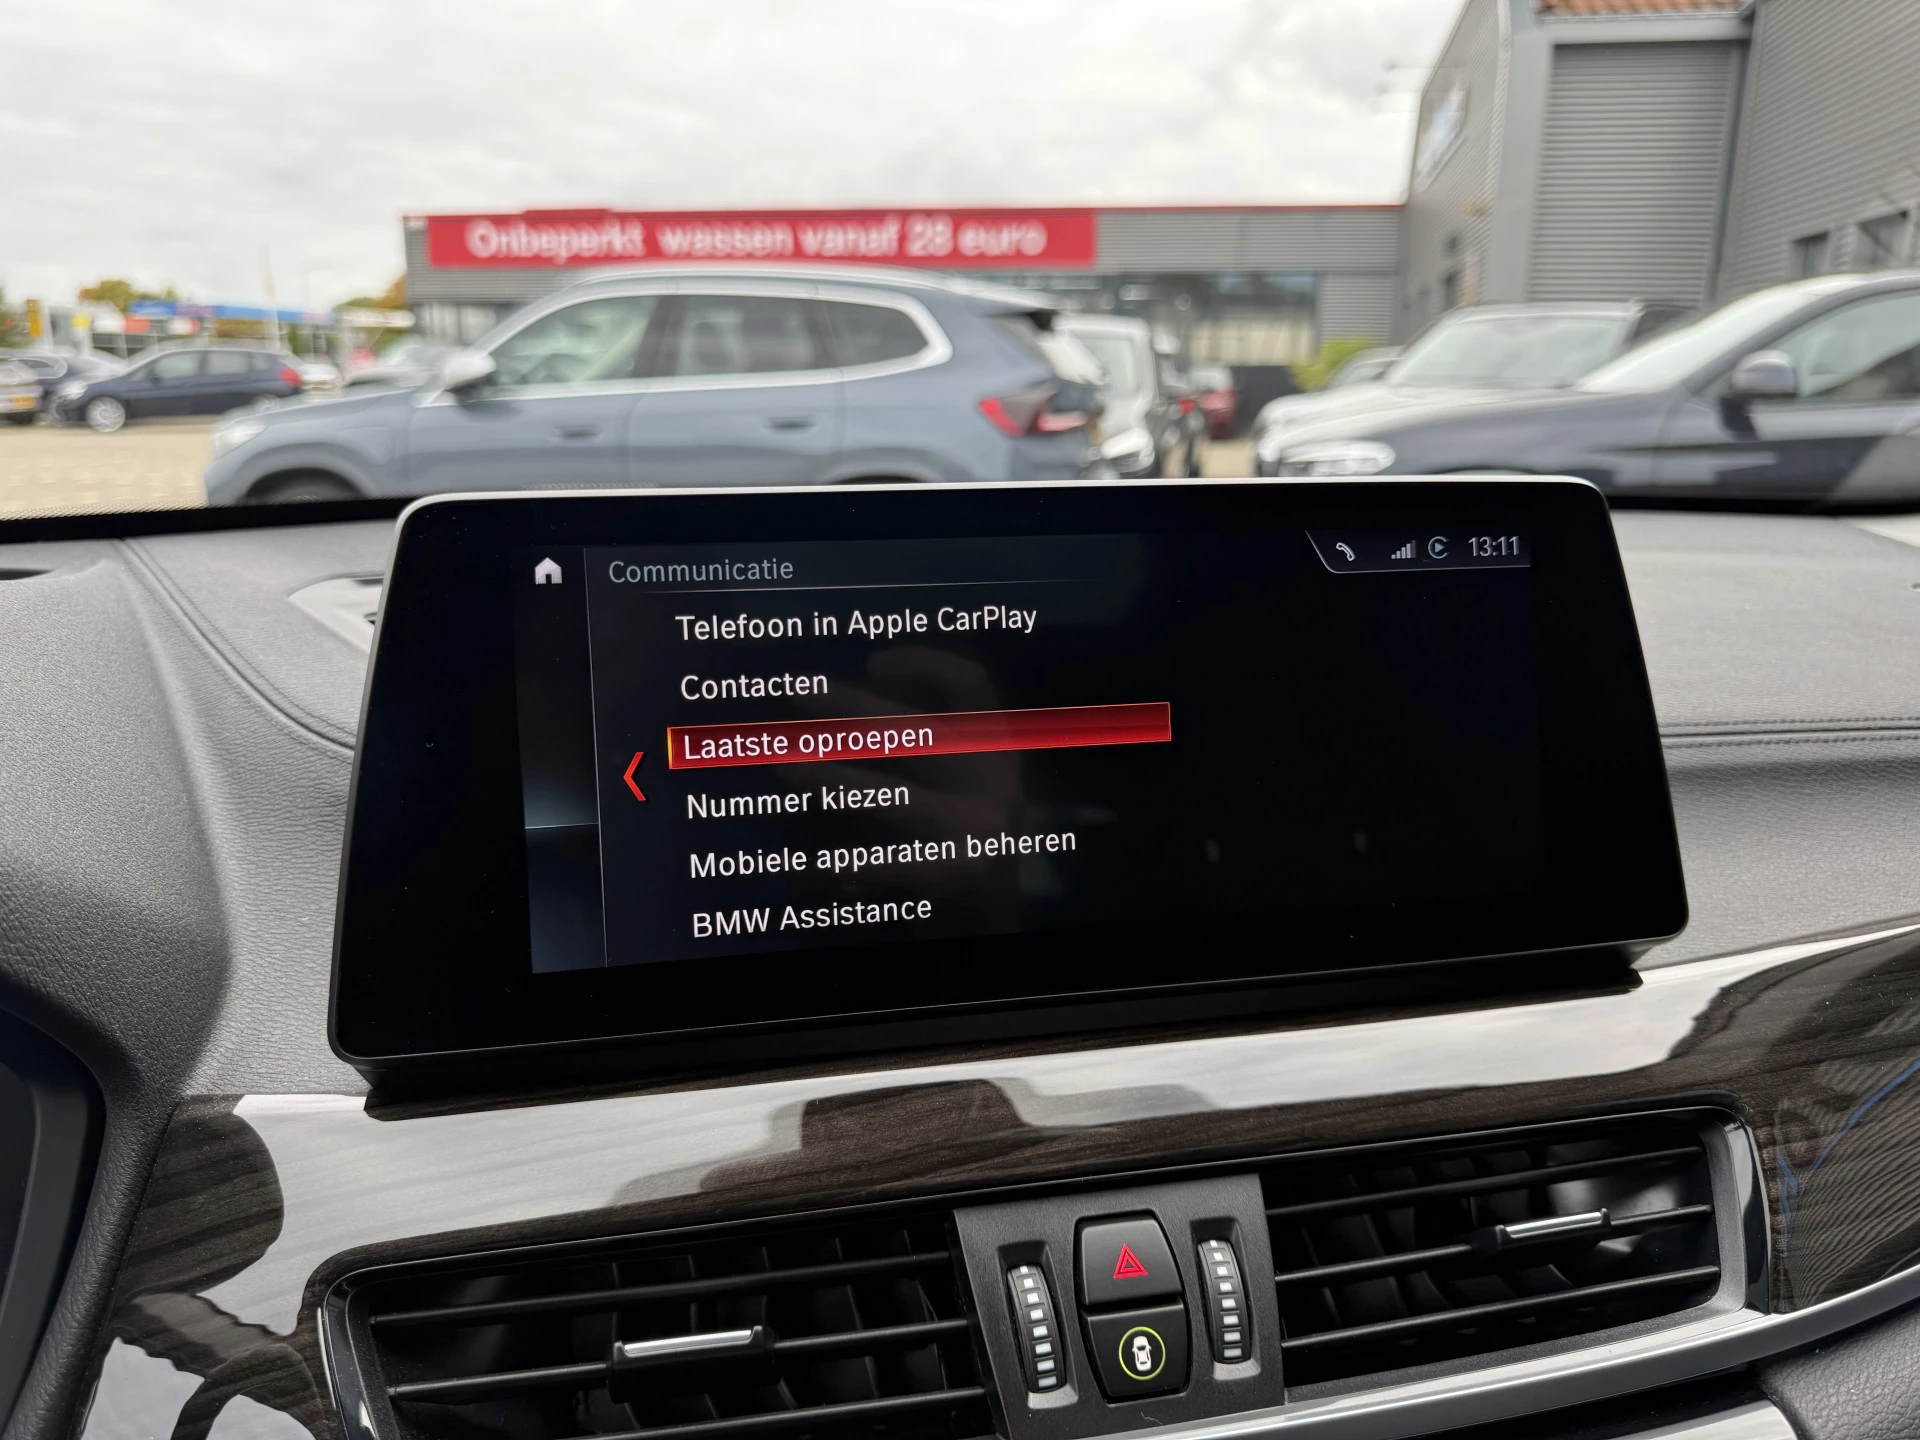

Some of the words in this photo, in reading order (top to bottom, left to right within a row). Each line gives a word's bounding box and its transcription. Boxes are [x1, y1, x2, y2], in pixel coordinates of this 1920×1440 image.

[464, 217, 646, 264] Onbeperkt
[656, 221, 794, 257] wassen
[799, 213, 899, 257] vanaf
[957, 220, 1047, 257] euro
[1468, 536, 1520, 557] 13:11
[608, 557, 795, 584] Communicatie
[675, 613, 803, 641] Telefoon
[813, 611, 838, 636] in
[847, 608, 928, 640] Apple
[937, 605, 1037, 634] CarPlay
[680, 671, 829, 701] Contacten
[684, 732, 789, 761] Laatste
[799, 725, 934, 758] oproepen
[687, 791, 812, 819] Nummer
[821, 783, 910, 811] kiezen
[689, 847, 807, 879] Mobiele
[816, 838, 956, 873] apparaten
[966, 830, 1077, 858] beheren
[692, 907, 771, 938] BMW
[780, 898, 932, 931] Assistance
